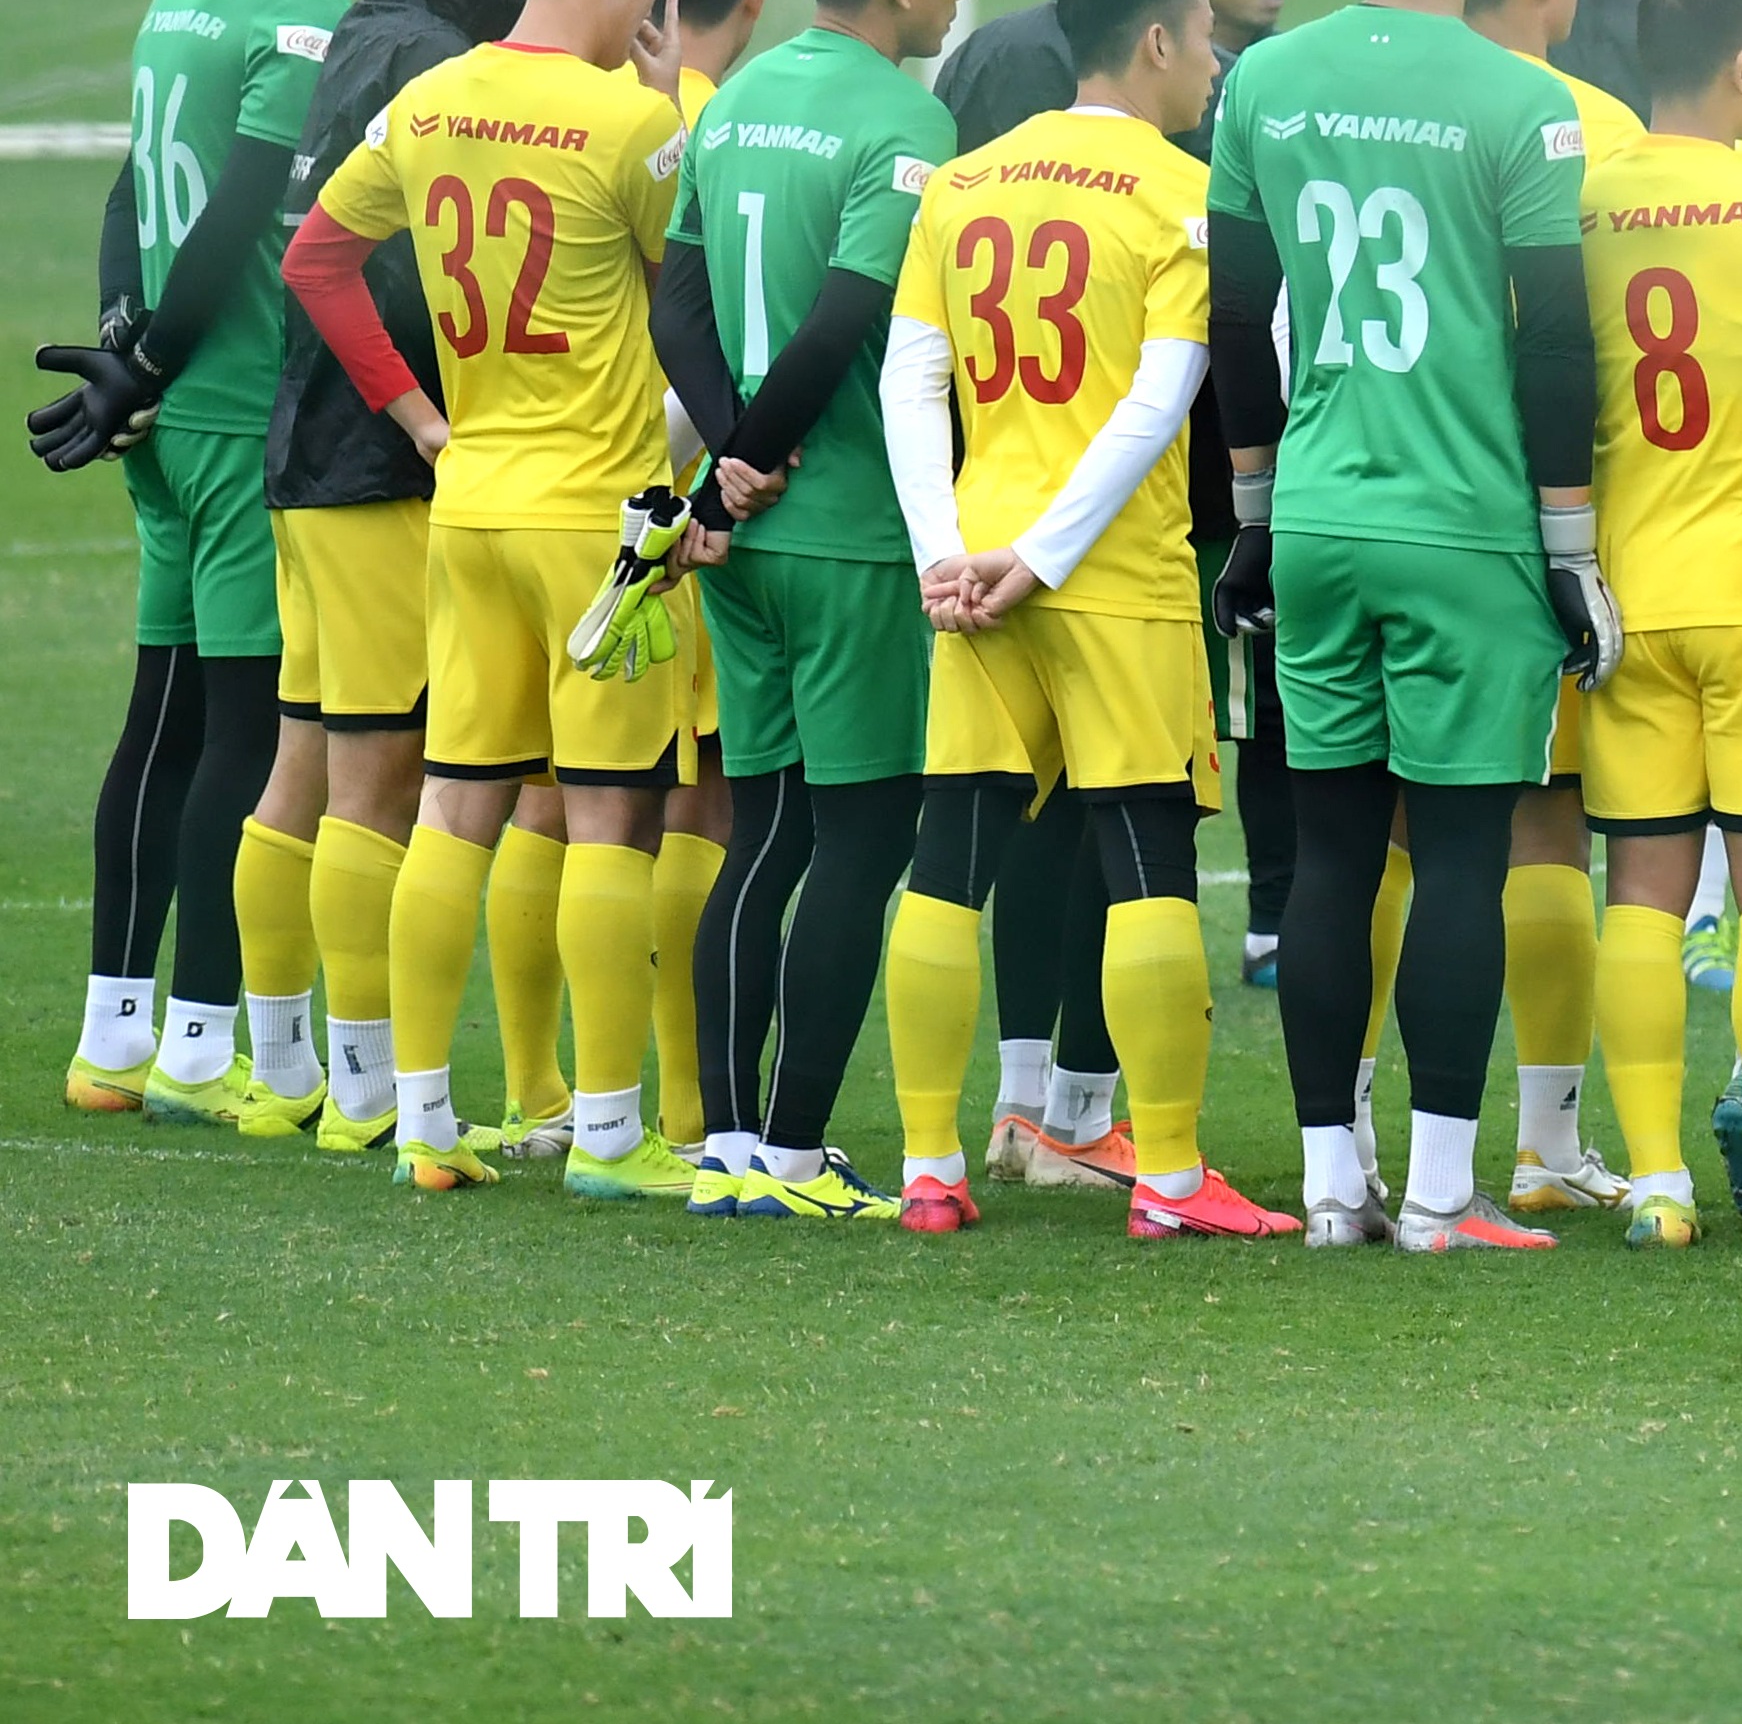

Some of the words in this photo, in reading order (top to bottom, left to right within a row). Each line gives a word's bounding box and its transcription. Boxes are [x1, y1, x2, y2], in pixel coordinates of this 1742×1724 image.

[152, 9, 227, 41] YANMAR
[132, 65, 208, 250] 36
[449, 116, 589, 152] YANMAR
[737, 122, 842, 160] YANMAR
[999, 160, 1140, 196] YANMAR
[1315, 112, 1467, 152] YANMAR
[426, 174, 570, 359] 32
[738, 191, 769, 376] 1
[956, 216, 1090, 404] 33
[1297, 180, 1430, 372] 23
[1625, 267, 1711, 452] 8
[587, 1115, 628, 1133] SPORT
